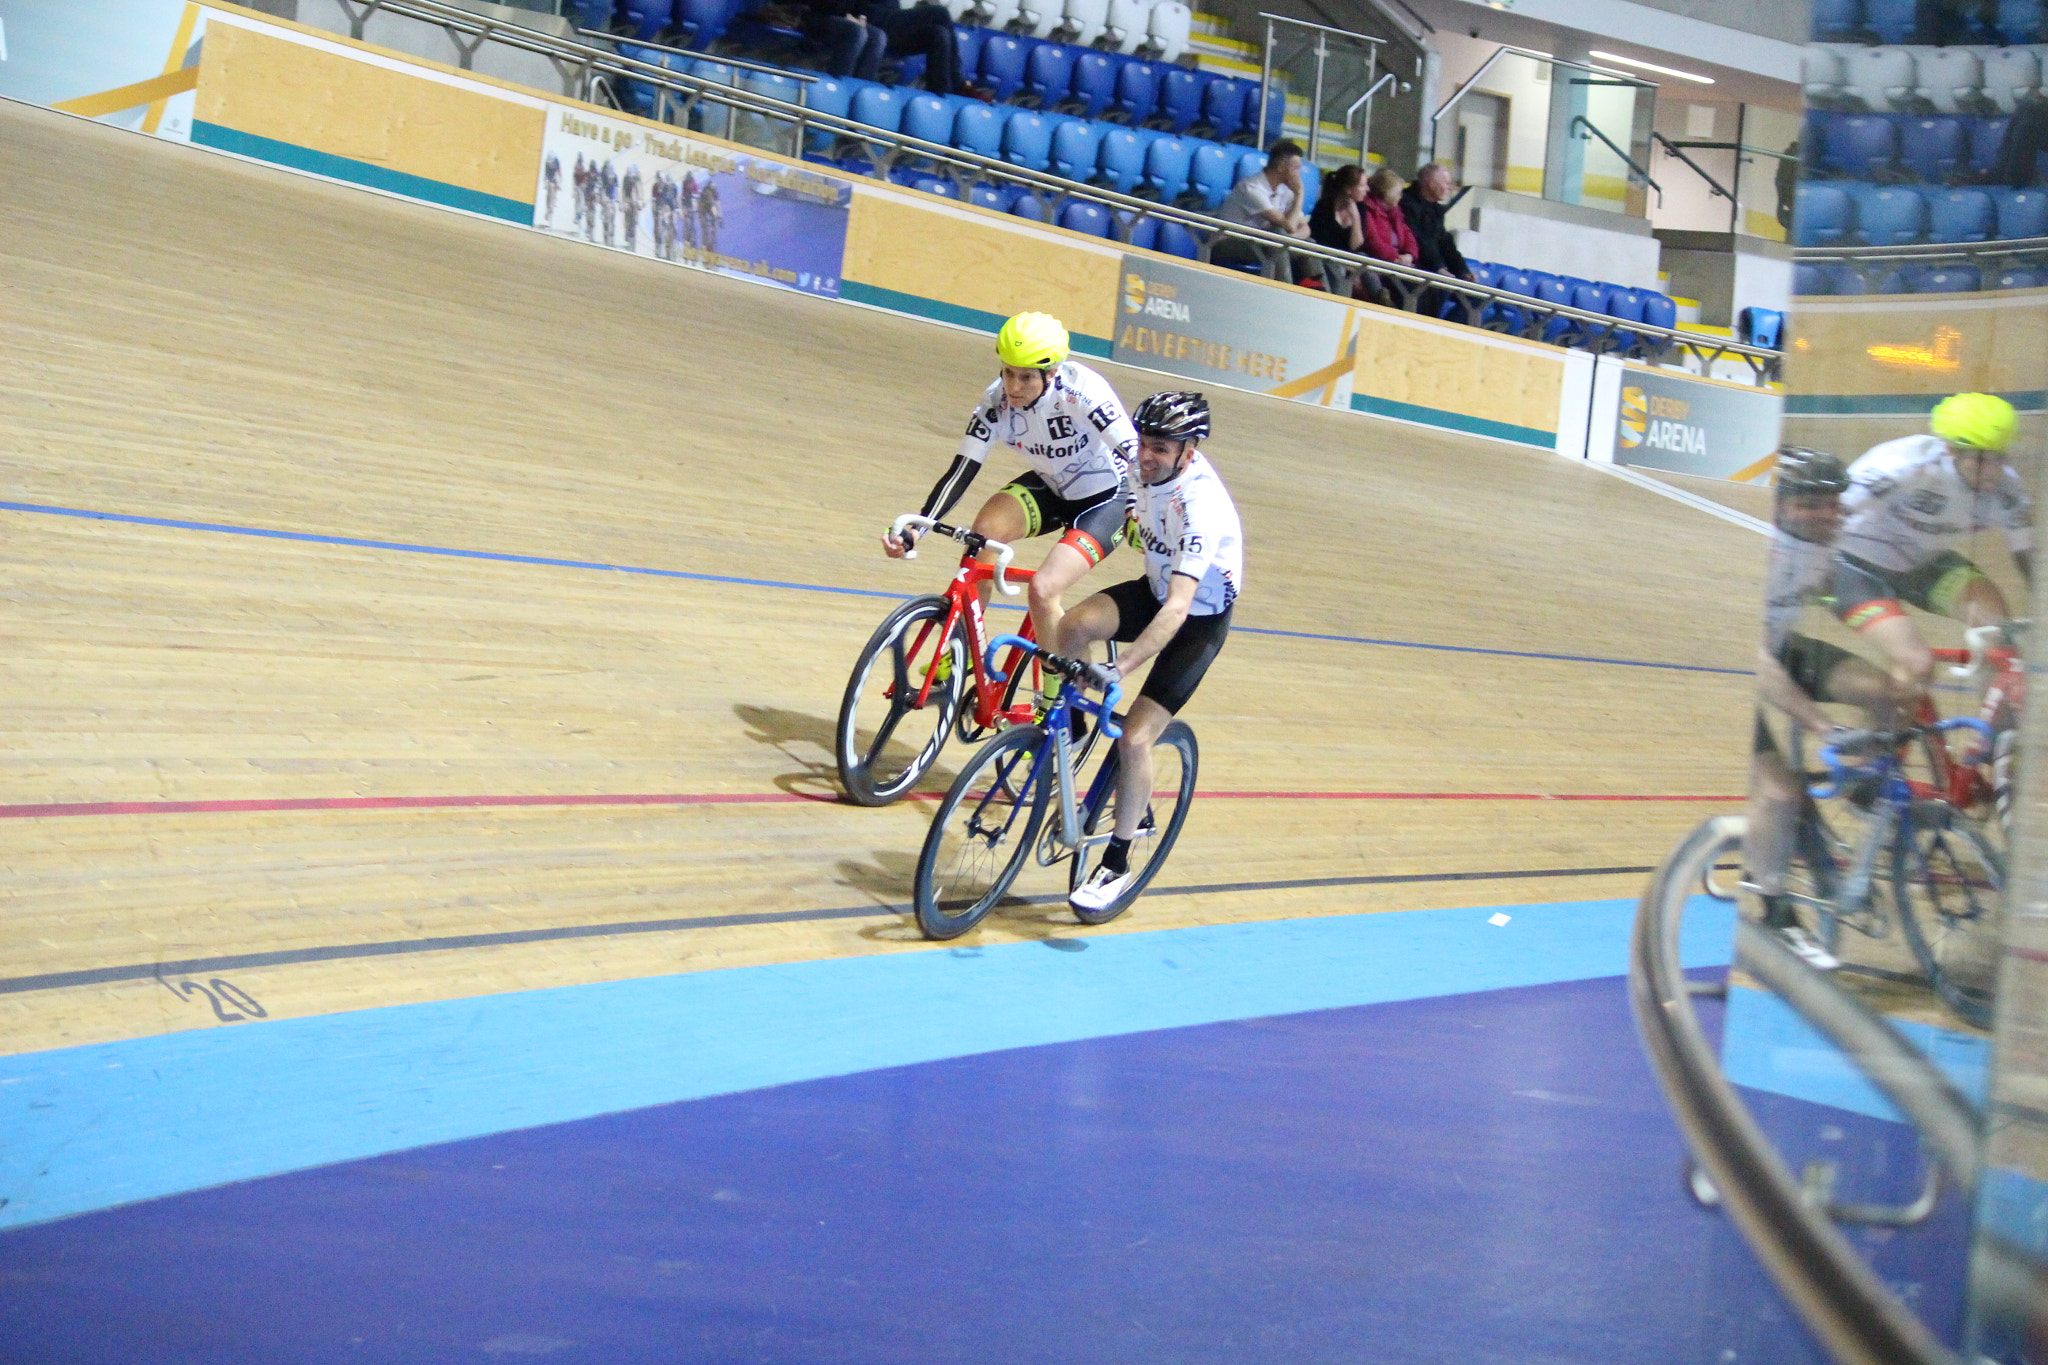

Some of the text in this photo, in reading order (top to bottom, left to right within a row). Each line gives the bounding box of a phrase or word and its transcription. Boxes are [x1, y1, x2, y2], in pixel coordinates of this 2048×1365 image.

[560, 111, 599, 141] Have
[601, 126, 611, 144] a
[1144, 296, 1190, 323] ARENA
[1237, 349, 1289, 382] HERE
[967, 416, 991, 440] 15
[1048, 417, 1076, 439] 15
[1091, 401, 1120, 429] 15
[1024, 433, 1089, 459] vittoria
[1646, 420, 1707, 456] ARENA
[1179, 536, 1203, 554] 15
